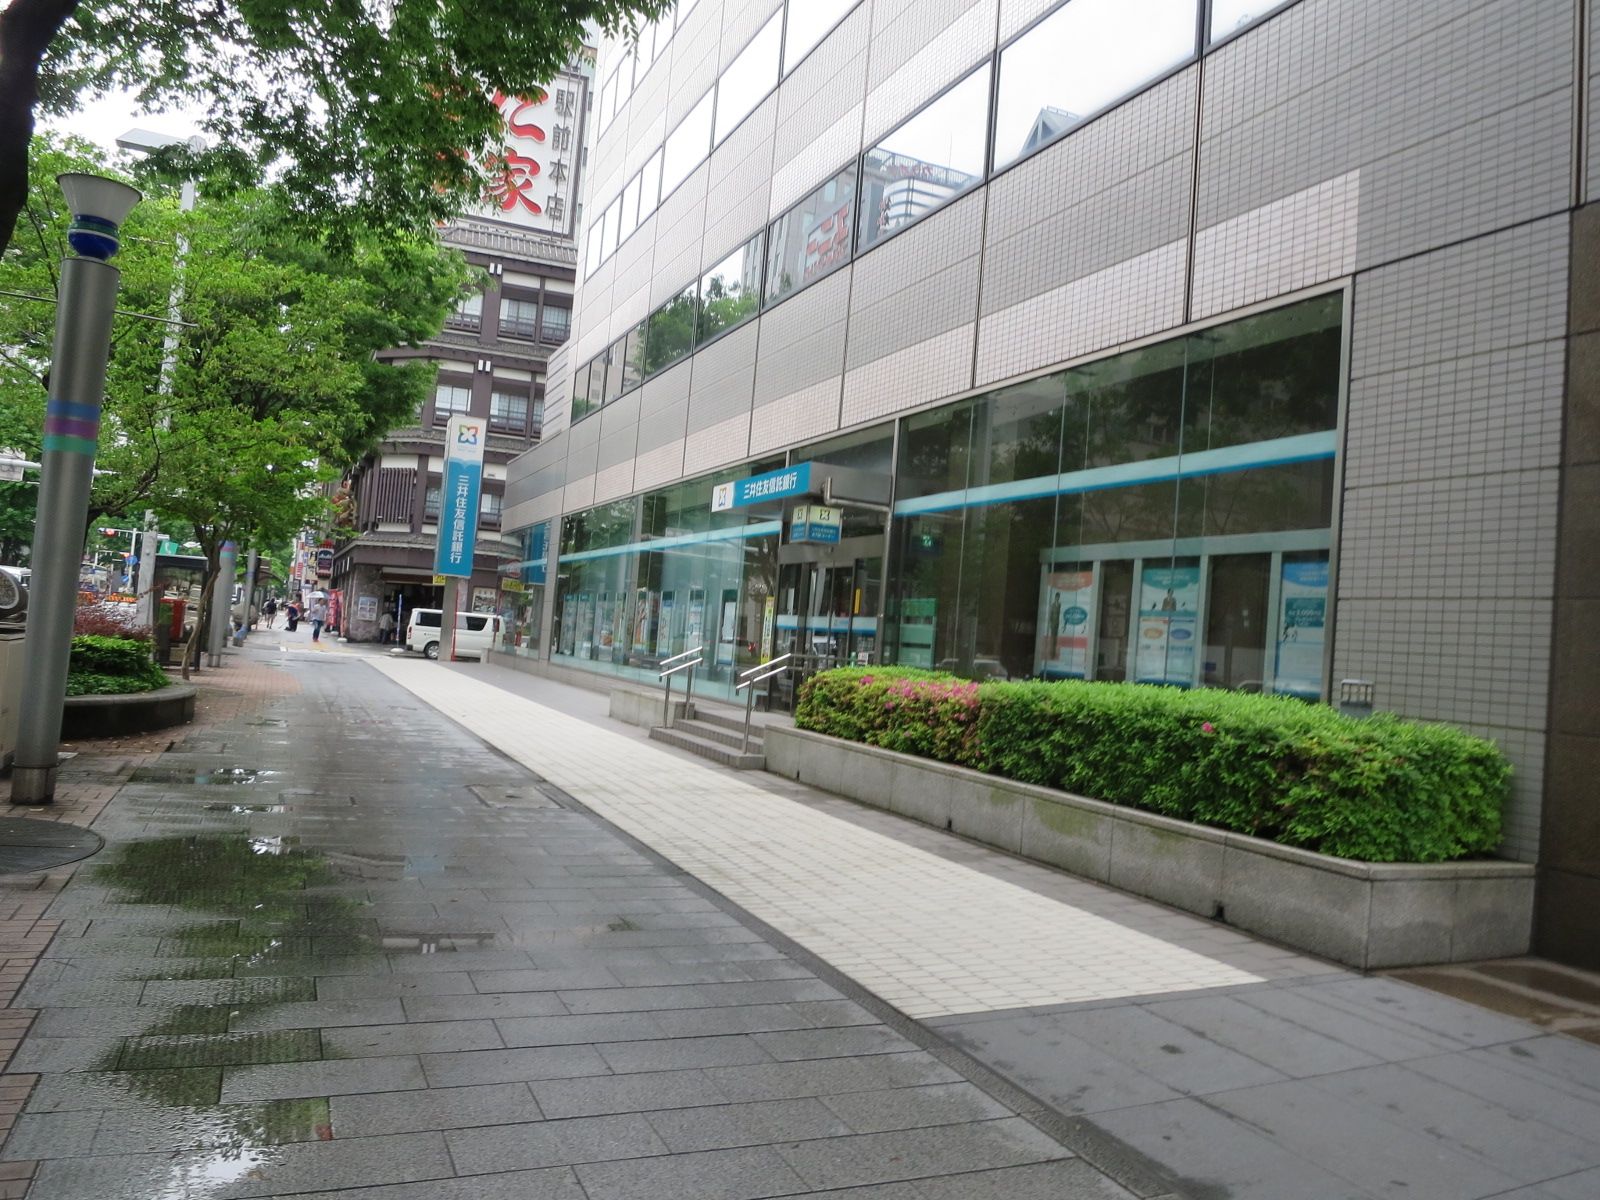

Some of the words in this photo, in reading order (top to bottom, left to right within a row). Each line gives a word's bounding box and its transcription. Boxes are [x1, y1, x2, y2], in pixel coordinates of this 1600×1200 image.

[546, 89, 576, 220] 駅前本店
[450, 475, 470, 564] 三井住友信託銀行
[743, 472, 797, 499] 三井住友信託銀行
